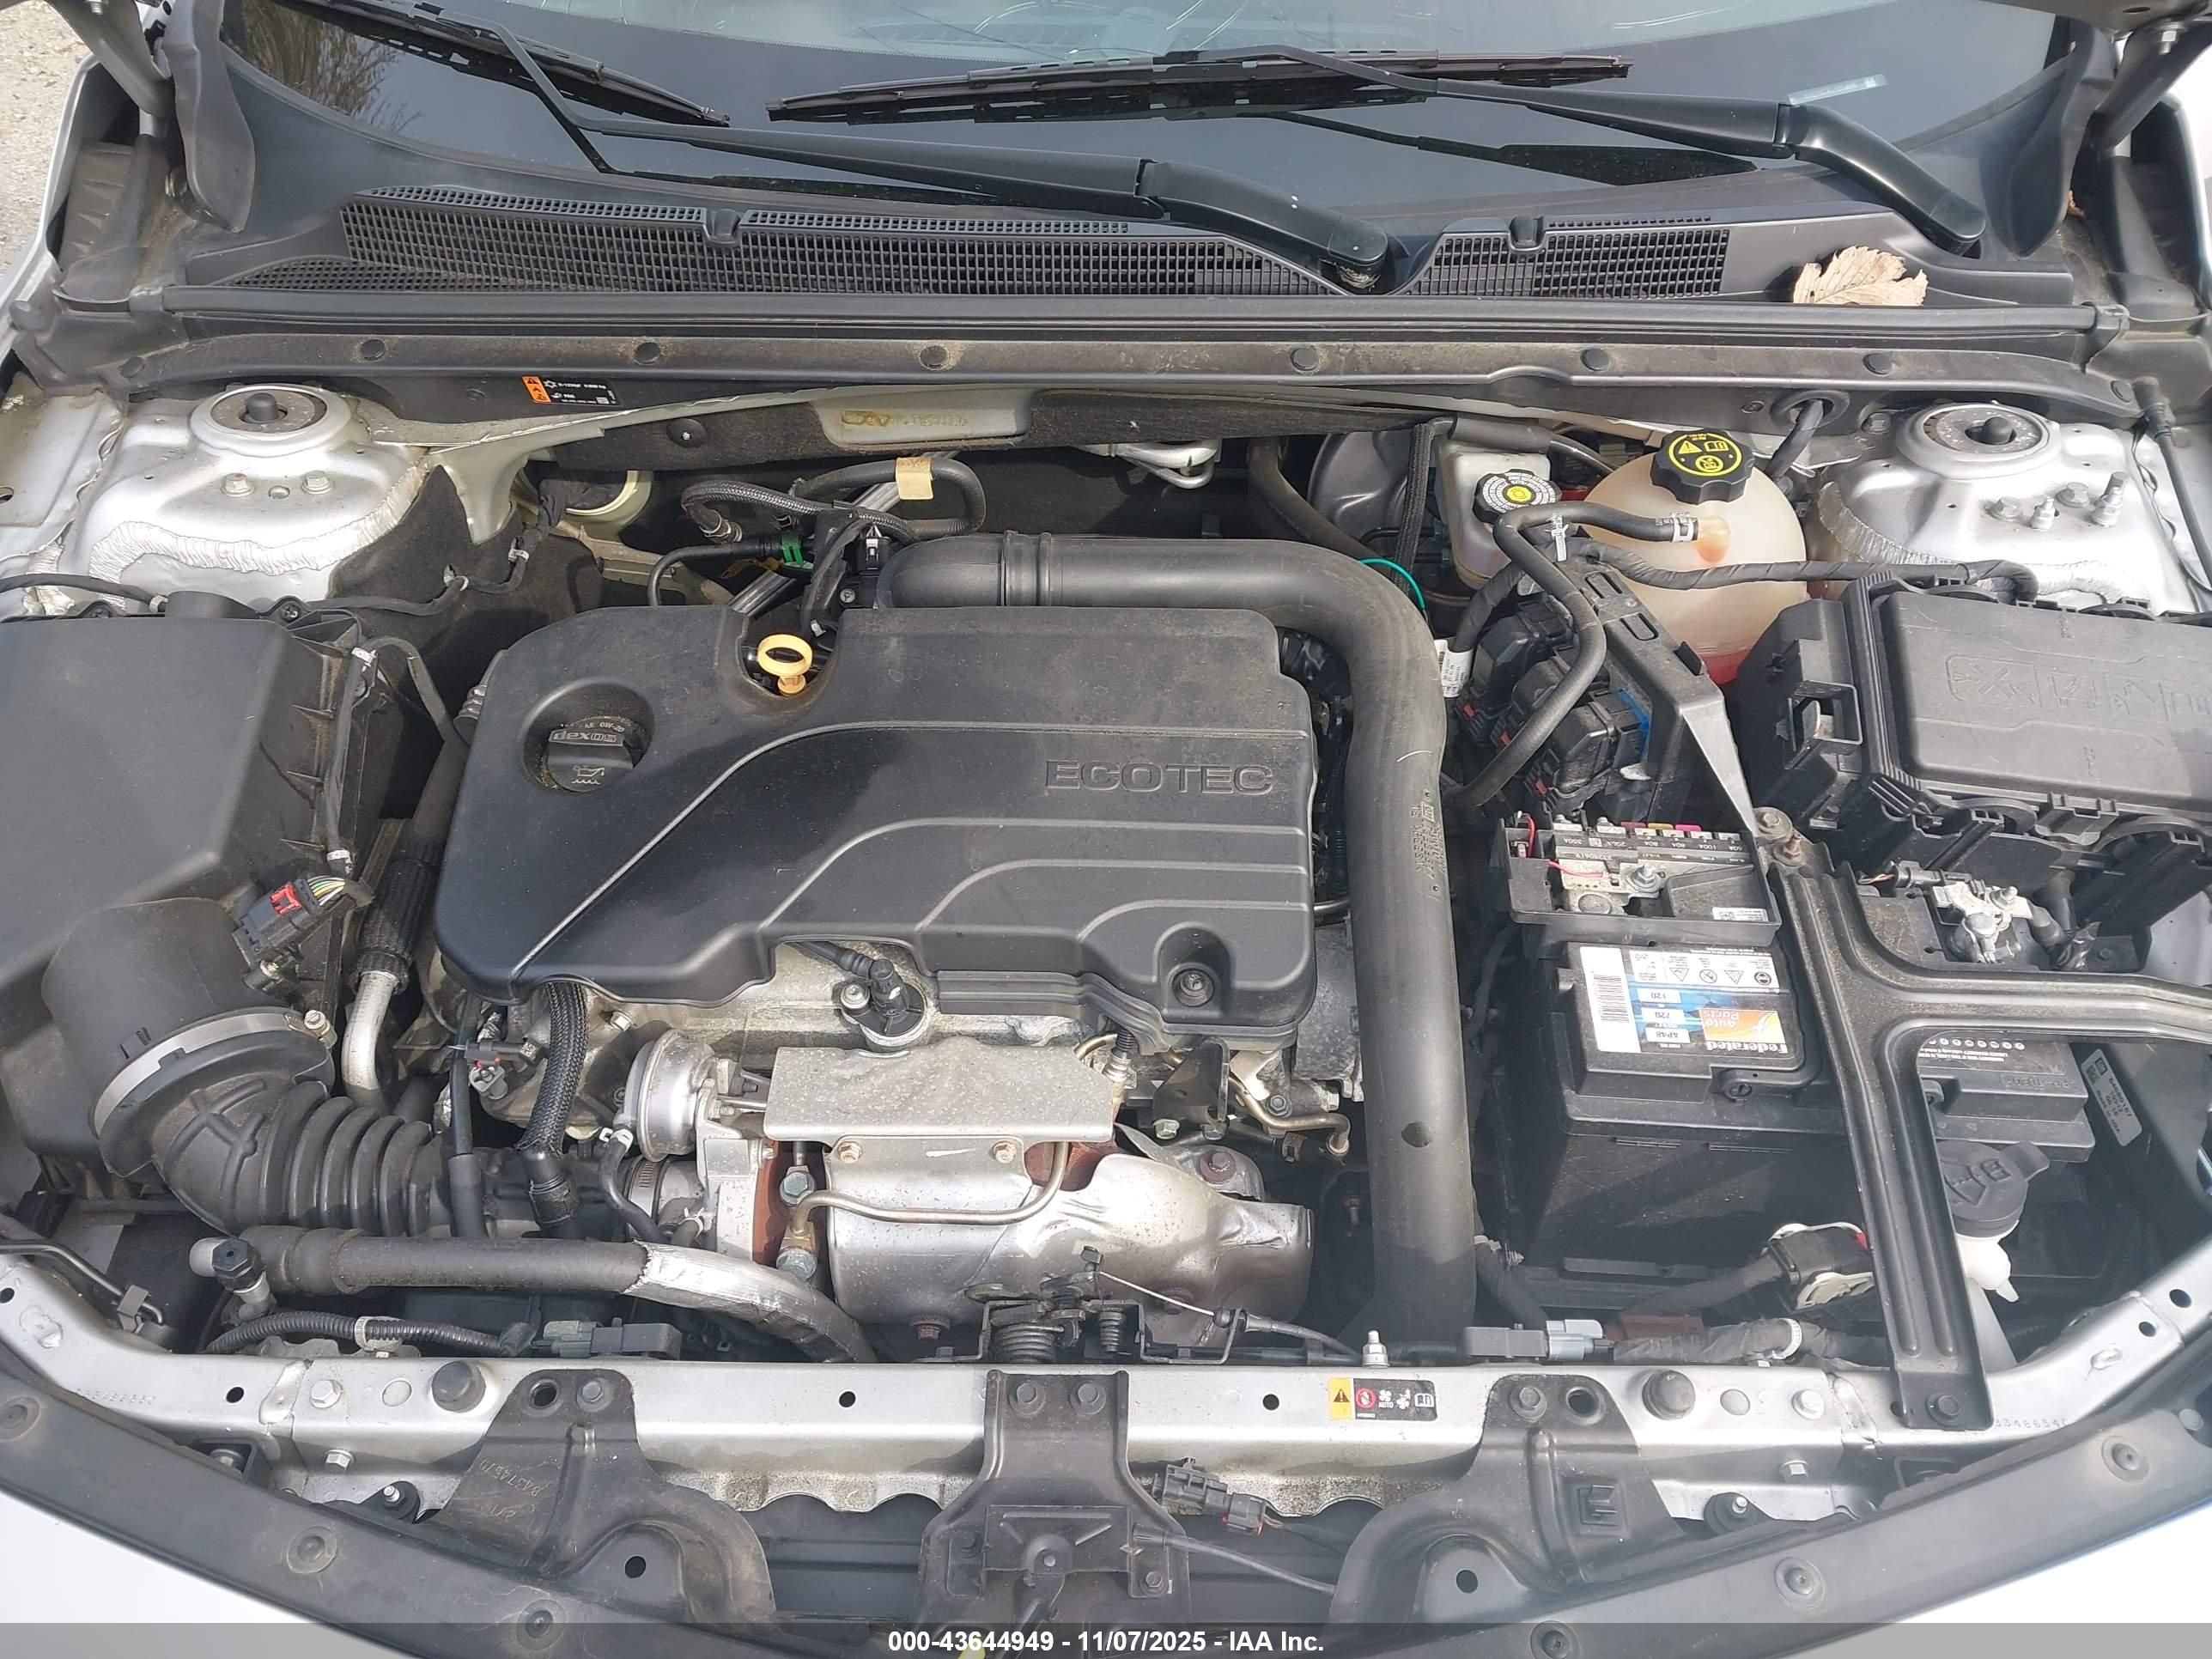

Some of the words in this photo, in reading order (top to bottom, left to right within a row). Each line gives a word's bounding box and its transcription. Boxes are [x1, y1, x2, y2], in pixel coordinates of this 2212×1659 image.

[554, 731, 617, 743] dexos
[1045, 760, 1273, 796] ECOTEC
[1703, 1010, 1740, 1020] Parts
[1708, 1019, 1735, 1029] Auto
[1706, 1041, 1789, 1054] Federated
